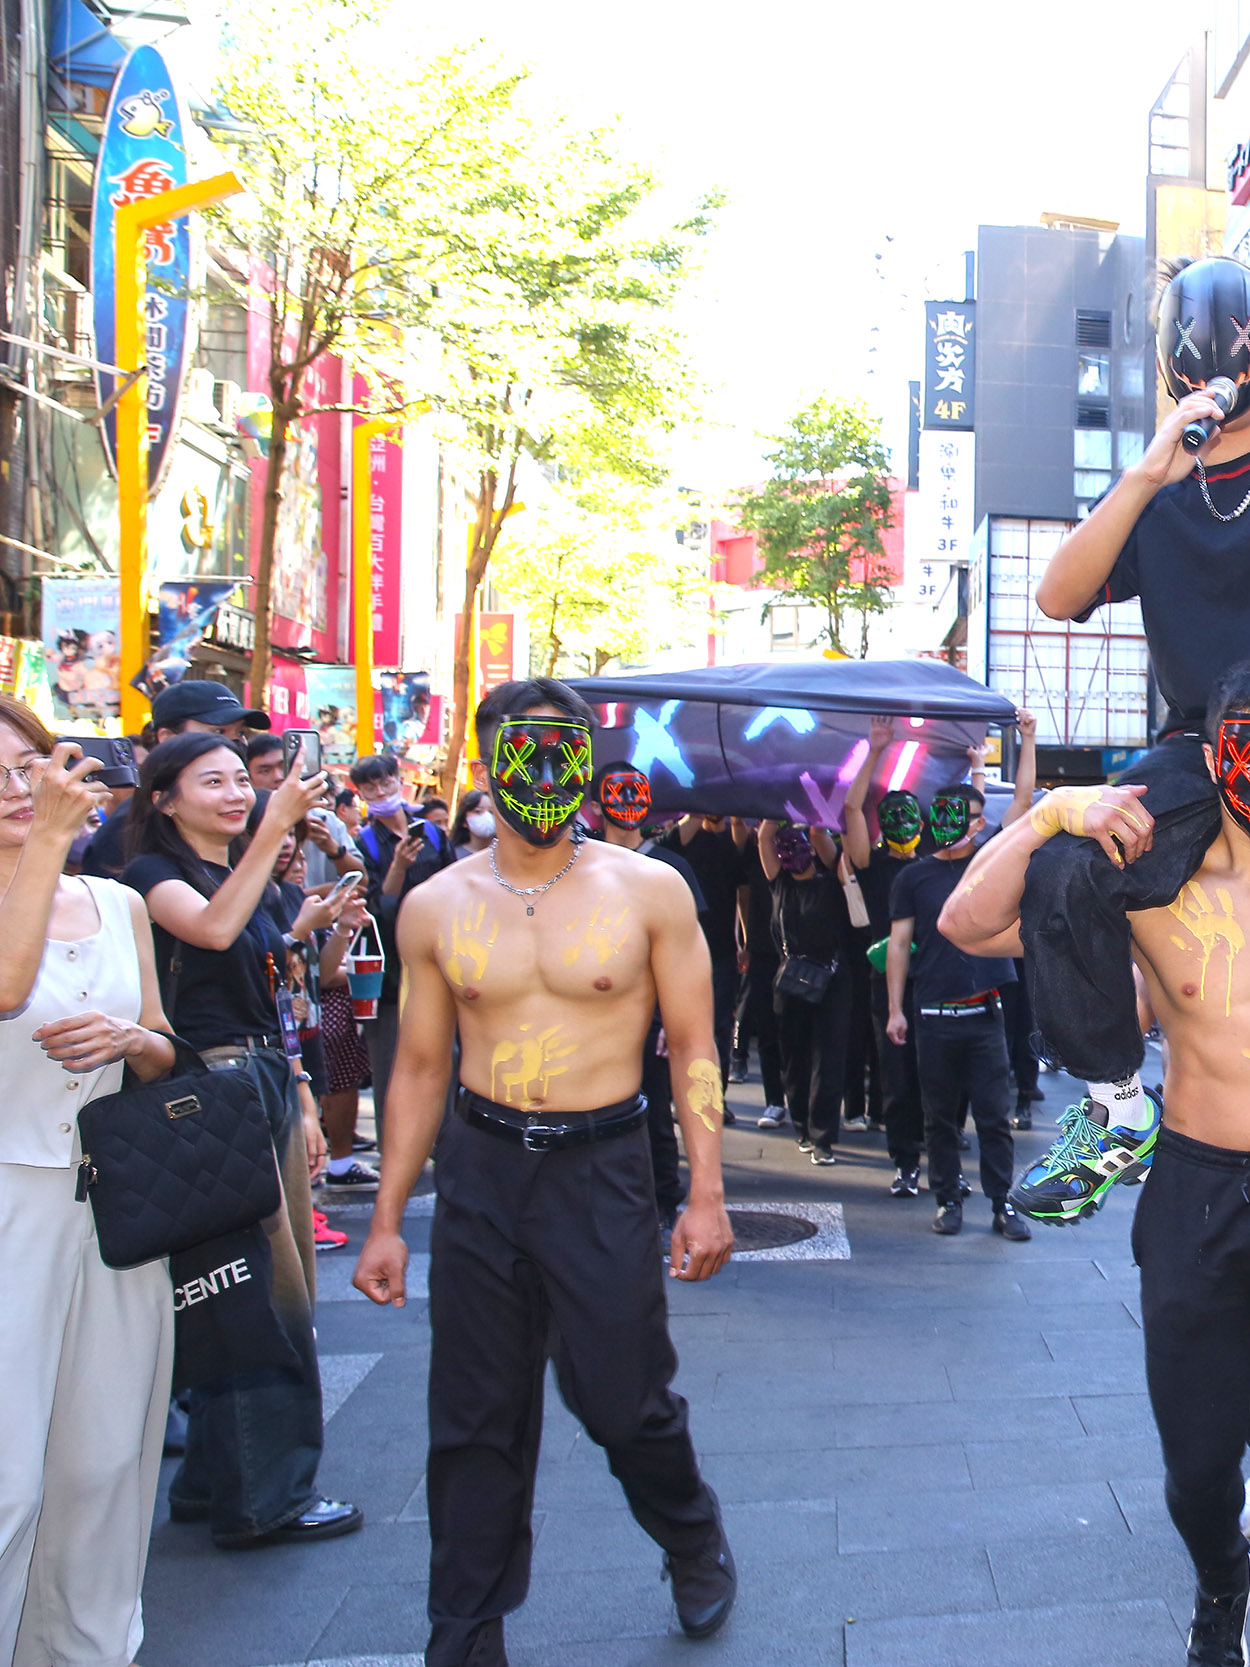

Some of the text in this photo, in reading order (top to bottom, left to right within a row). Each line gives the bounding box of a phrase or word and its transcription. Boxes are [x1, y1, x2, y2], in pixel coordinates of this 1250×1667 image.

[934, 399, 968, 420] 4F
[937, 538, 959, 551] 3F
[918, 584, 937, 596] 3F
[1114, 1086, 1139, 1101] adidas
